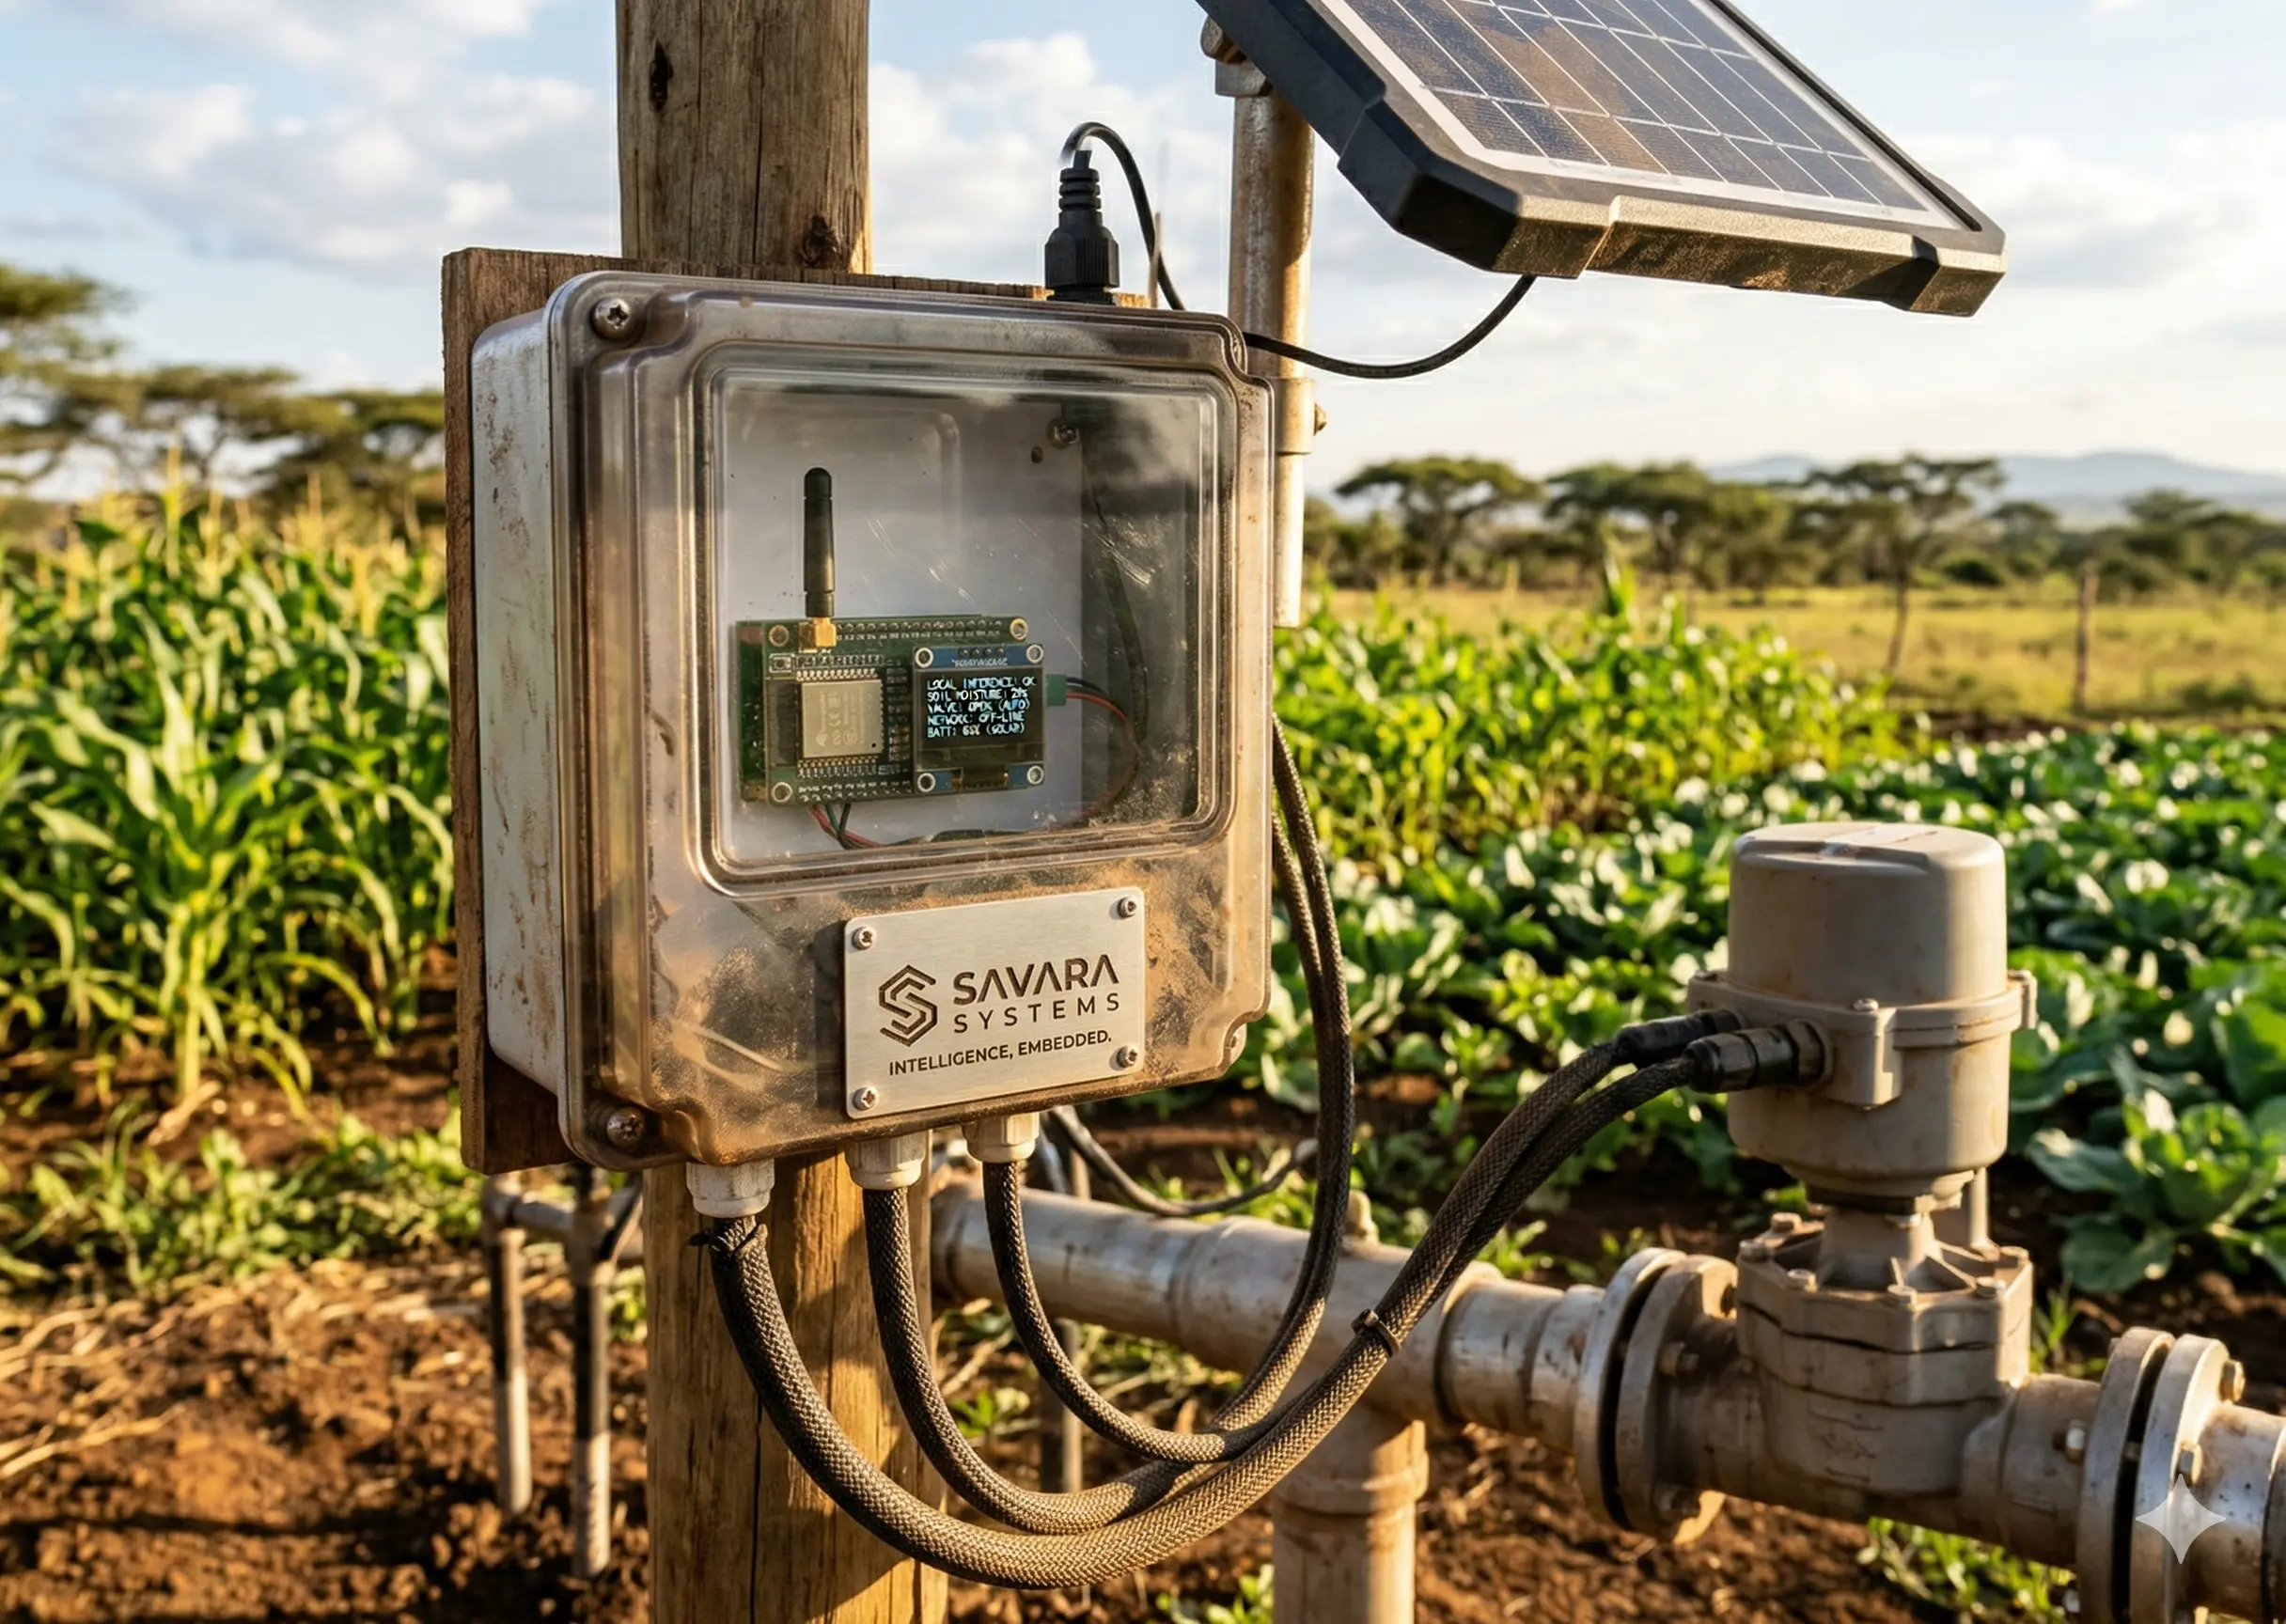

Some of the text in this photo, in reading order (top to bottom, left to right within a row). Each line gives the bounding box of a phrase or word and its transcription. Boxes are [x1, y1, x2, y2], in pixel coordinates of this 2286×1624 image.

[927, 692, 951, 702] SOIL
[927, 726, 957, 739] BATT:
[952, 953, 1120, 1006] SAVARA
[953, 992, 1120, 1034] SYSTEMS
[888, 1030, 1112, 1076] INTELLIGENCE, EMBEDDED.
